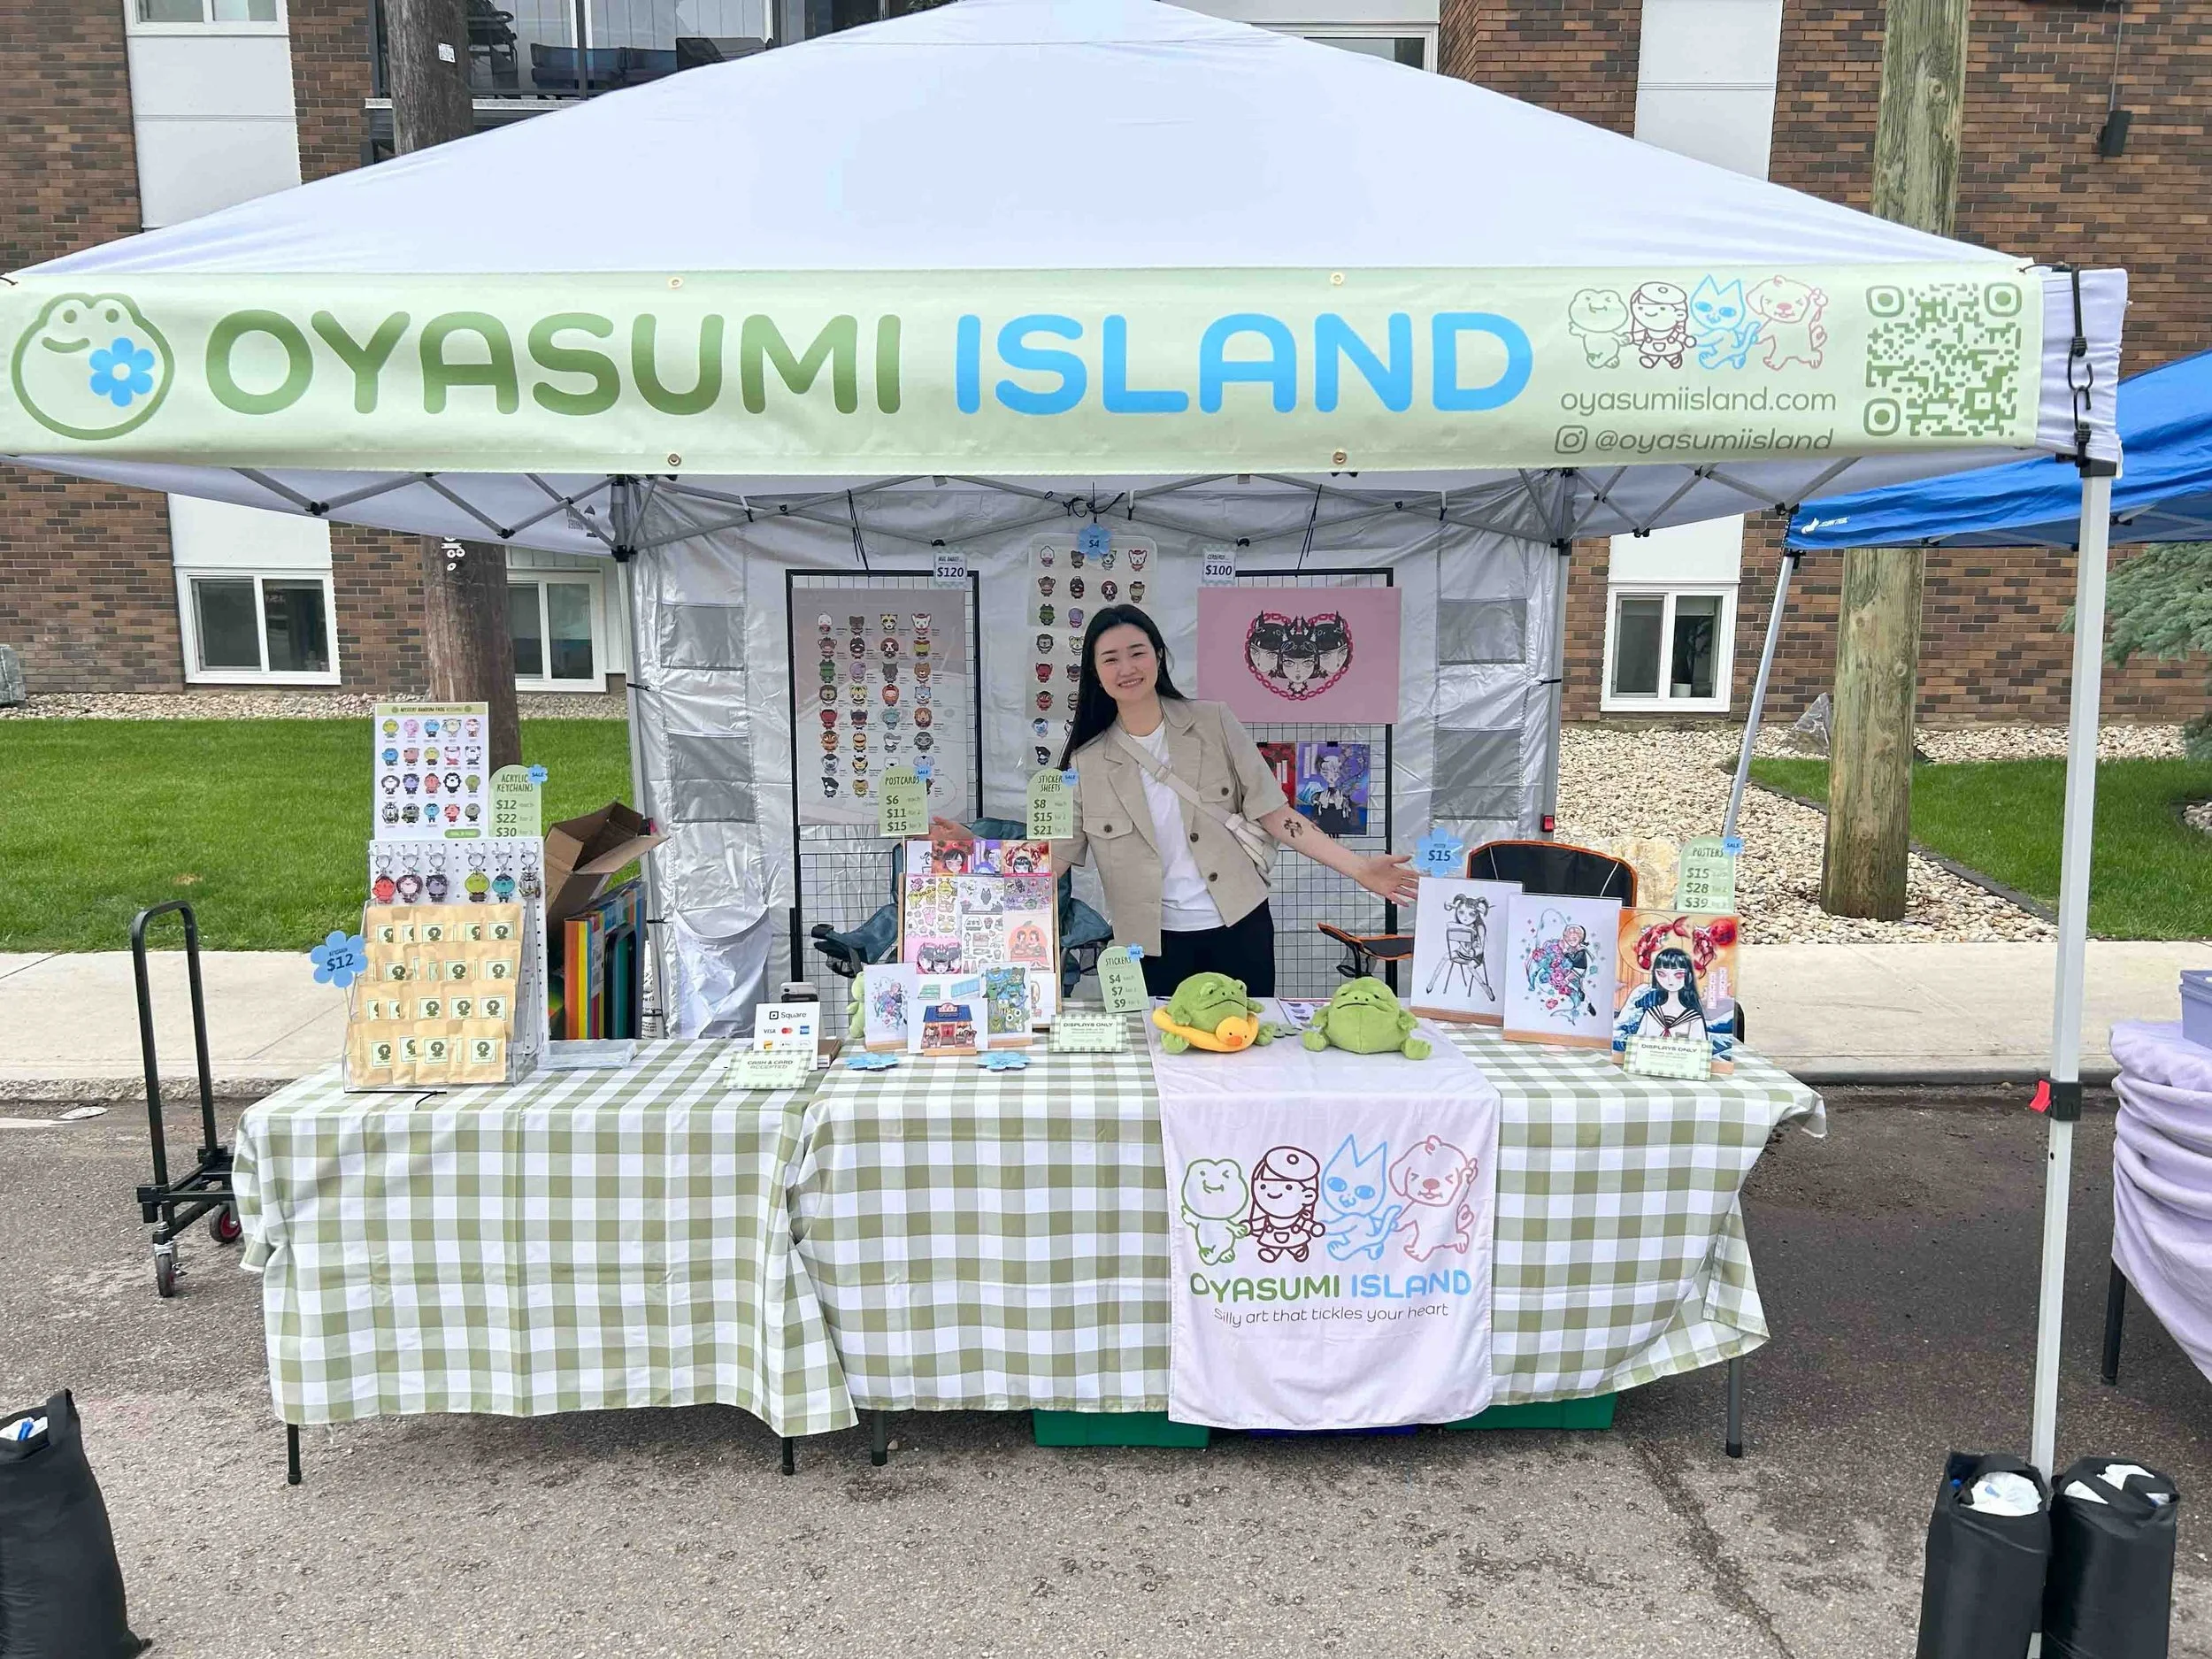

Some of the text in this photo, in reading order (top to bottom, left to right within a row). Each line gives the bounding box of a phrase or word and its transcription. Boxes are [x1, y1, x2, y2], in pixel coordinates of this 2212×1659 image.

[206, 309, 1533, 416] OYASUMI ISLAND
[1561, 386, 1836, 417] oyasumiisland.com
[1595, 427, 1834, 454] @oyasumiisland
[937, 566, 964, 578] $120
[1205, 565, 1233, 576] $100
[501, 774, 528, 783] ACRYLIC
[885, 776, 920, 786] POSTCARDS
[496, 783, 534, 792] KEYCHAINS
[1041, 783, 1061, 792] SHEETS
[495, 799, 518, 810] $12
[886, 795, 899, 805] $6
[1033, 798, 1047, 809] $8
[495, 813, 518, 823] $22
[887, 808, 907, 818] $11
[1033, 812, 1053, 822] $15
[495, 826, 518, 837] $30
[887, 821, 907, 832] $15
[1033, 826, 1053, 835] $21
[1428, 849, 1451, 861] $15
[1692, 847, 1724, 857] POSTERS
[1686, 868, 1710, 879] $15
[1686, 882, 1709, 894] $28
[1685, 897, 1709, 908] $39
[326, 953, 354, 972] $12
[1105, 956, 1132, 966] STICKERS
[1109, 974, 1121, 984] $4
[1111, 987, 1123, 996] $7
[1114, 998, 1126, 1008] $9
[1190, 1269, 1472, 1303] OYASUMI ISLAND
[1214, 1303, 1449, 1328] Silly art that tickles your heart
